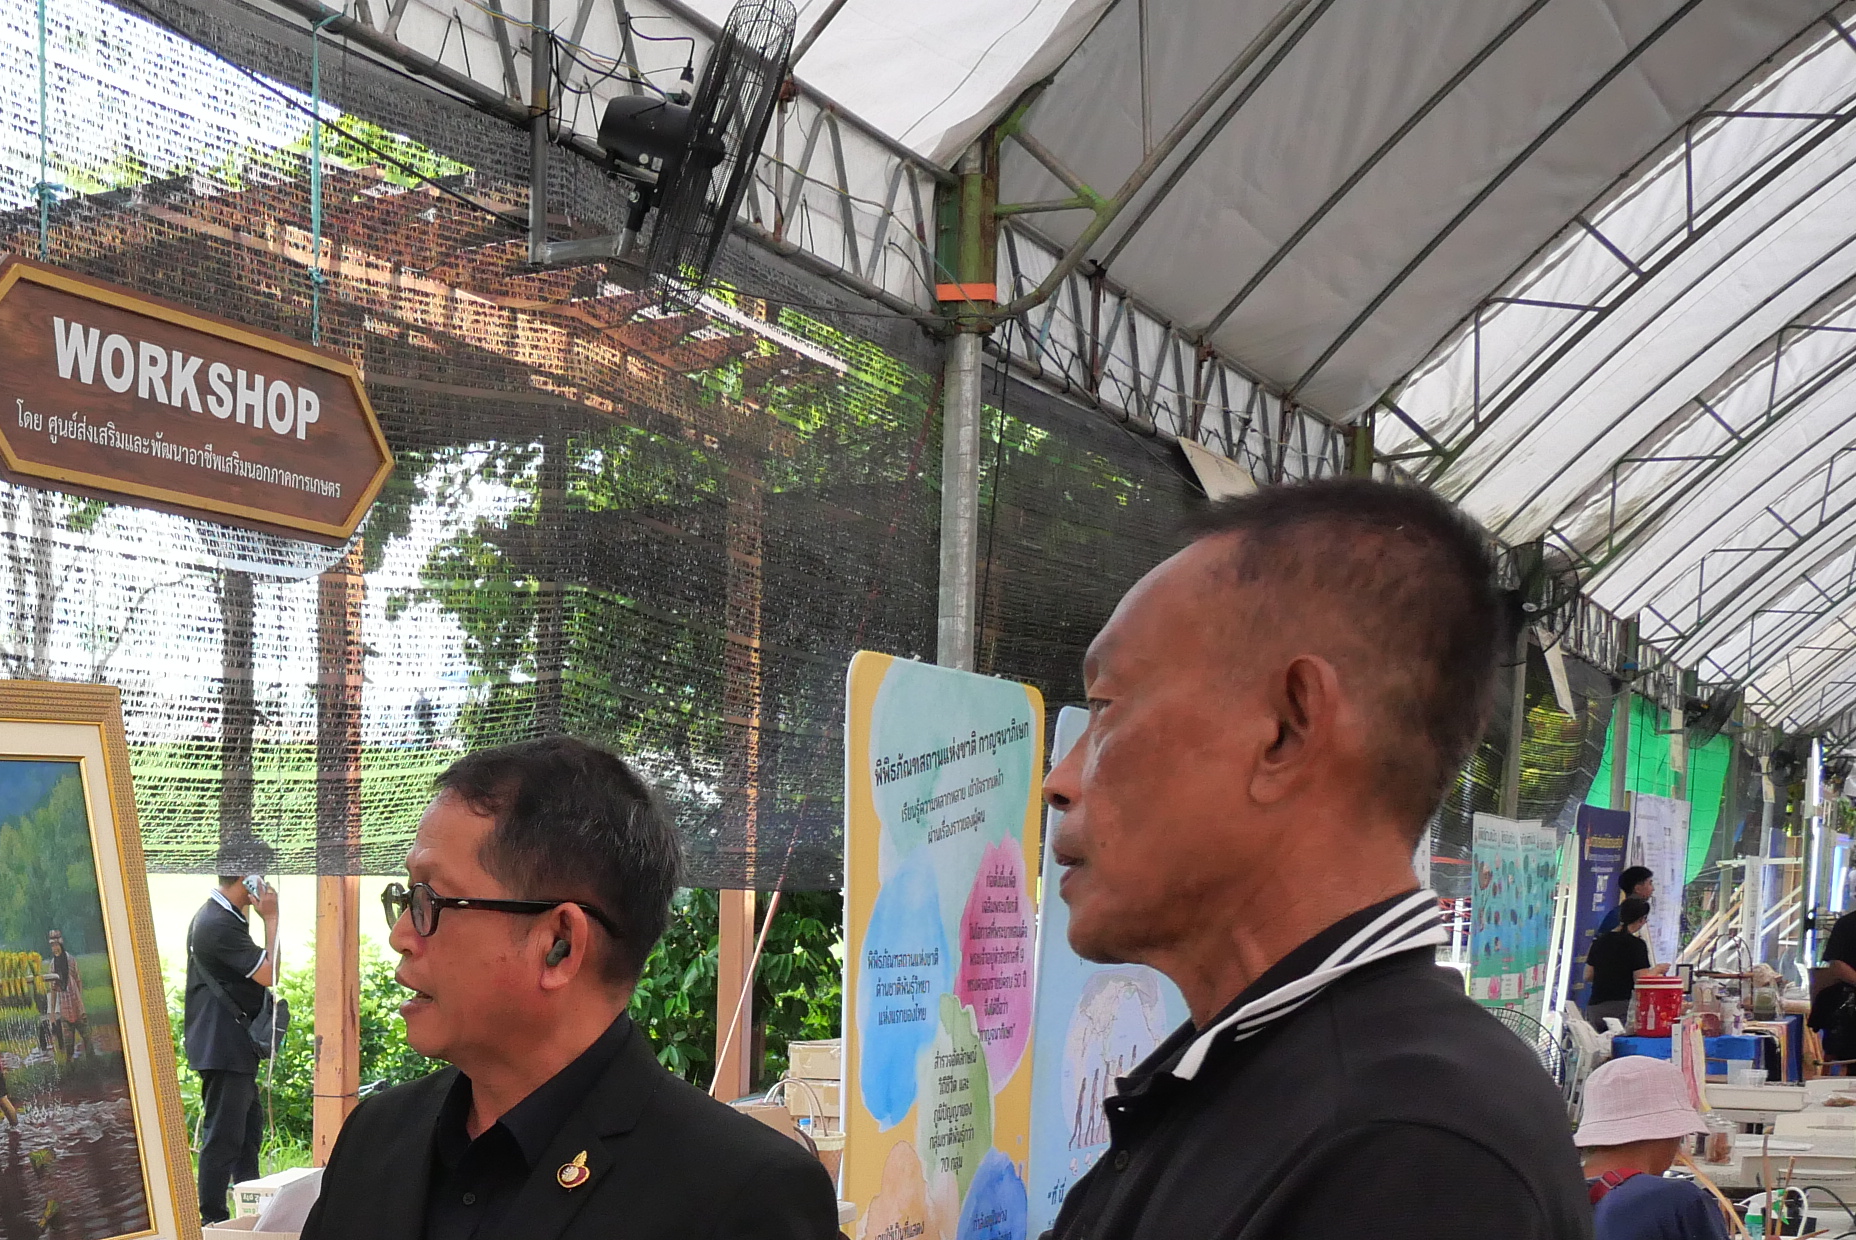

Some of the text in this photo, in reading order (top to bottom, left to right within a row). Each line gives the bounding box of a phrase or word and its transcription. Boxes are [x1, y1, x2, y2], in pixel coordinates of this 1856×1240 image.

[53, 316, 320, 440] WORKSHOP
[16, 398, 341, 498] โดย ศูนย์ส่งเสริมและพัฒนาอาชีพเสริมนอกภาคการเกษตร
[875, 718, 1029, 786] พิพิธภัณฑสถานแห่งชาติ กาญจนาภิเษก
